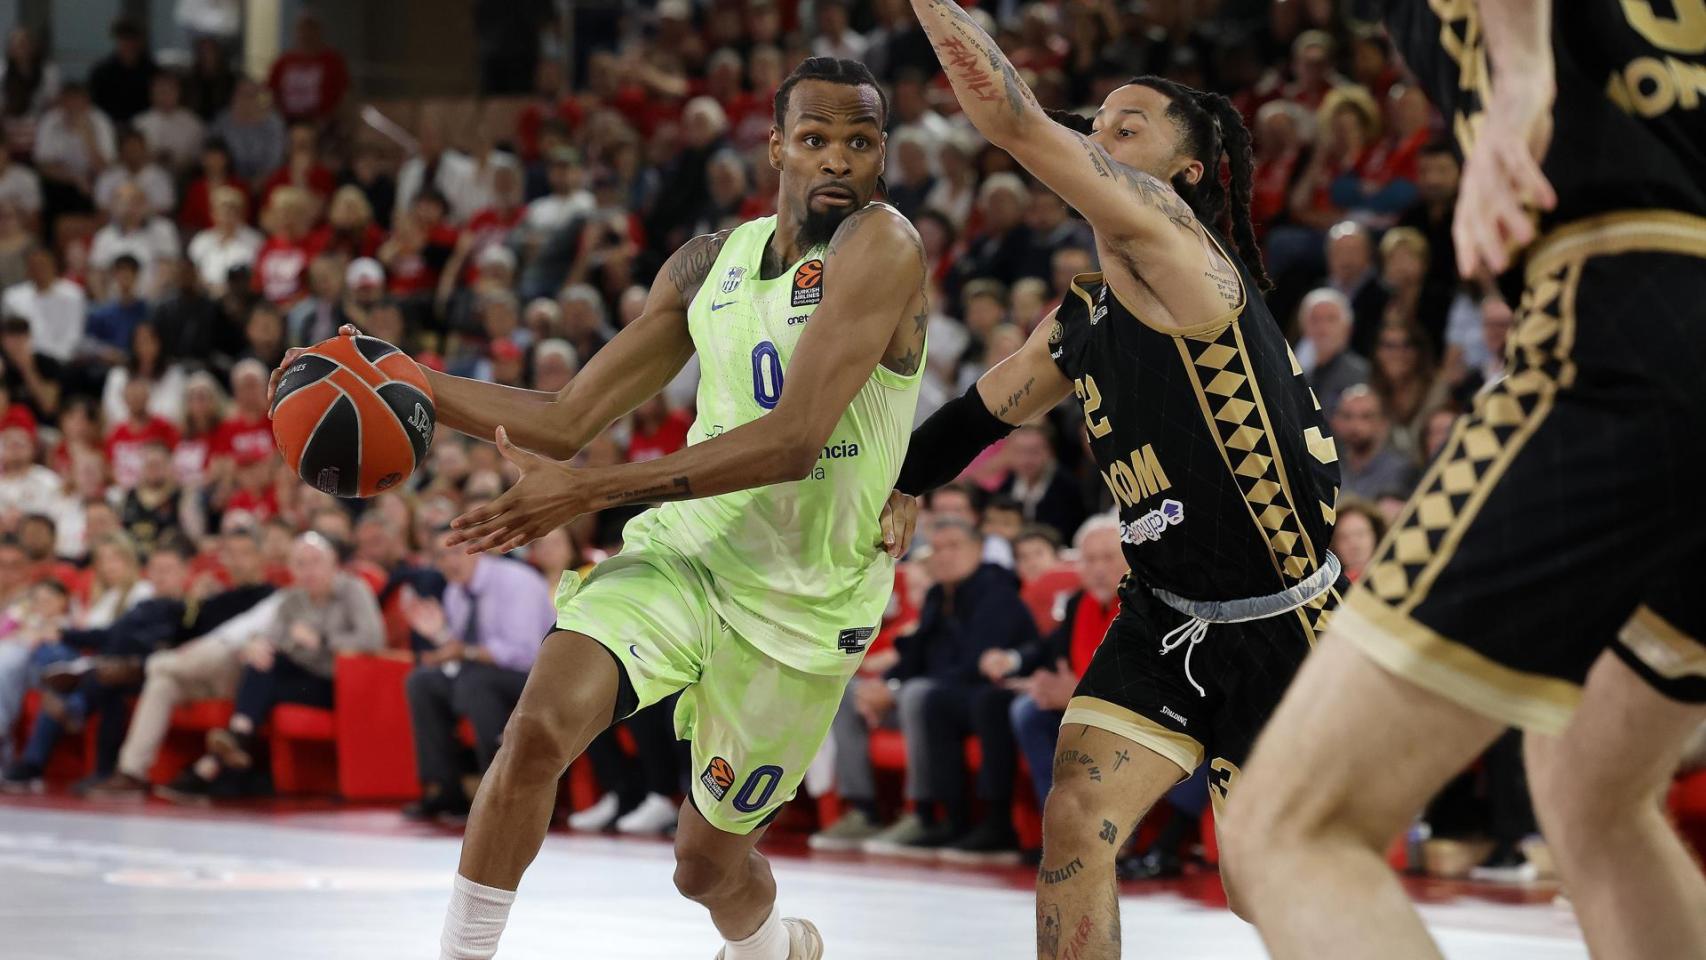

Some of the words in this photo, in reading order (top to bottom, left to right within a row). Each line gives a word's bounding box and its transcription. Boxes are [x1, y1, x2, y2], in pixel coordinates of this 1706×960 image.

[793, 292, 820, 301] AIRLINES
[794, 287, 820, 296] TURKISH
[751, 340, 784, 410] 0
[732, 765, 784, 813] 0
